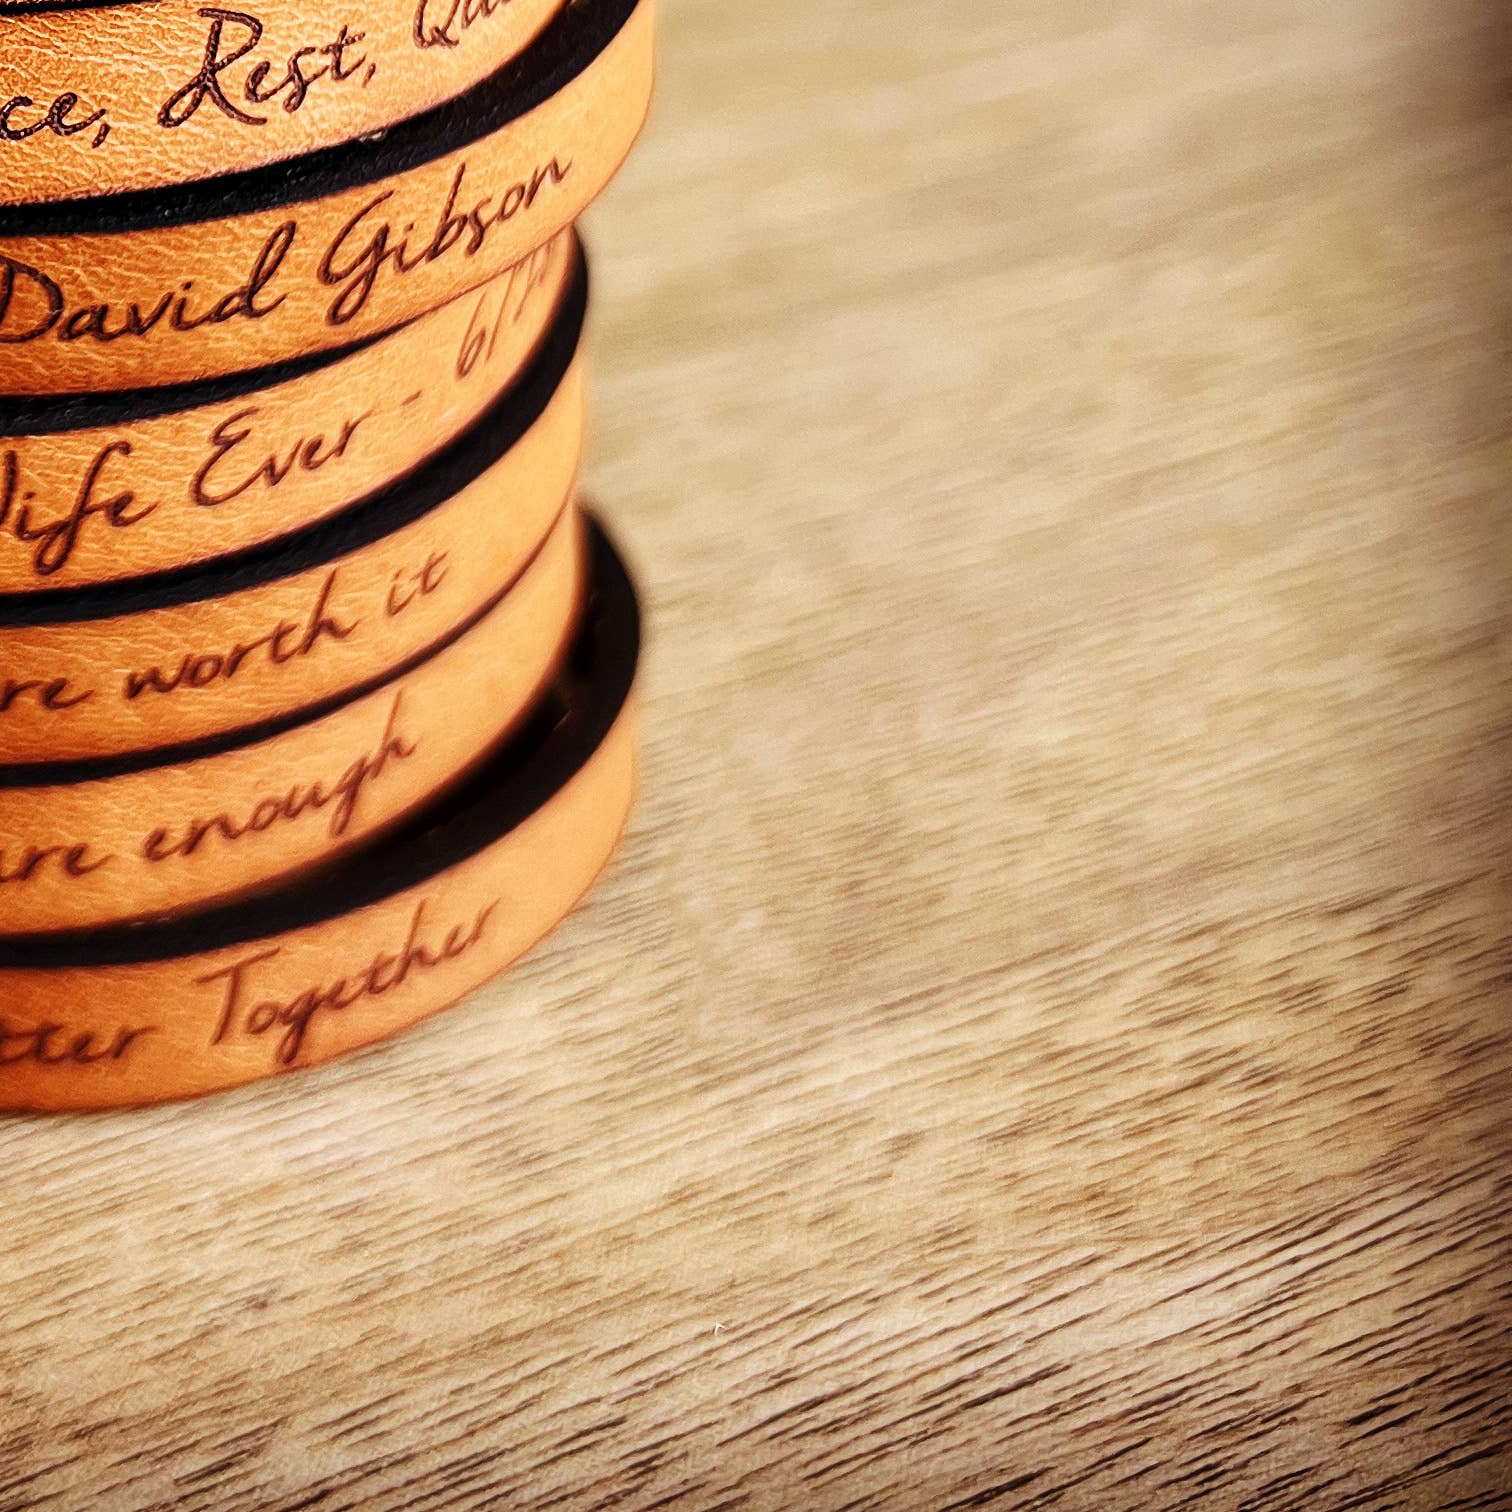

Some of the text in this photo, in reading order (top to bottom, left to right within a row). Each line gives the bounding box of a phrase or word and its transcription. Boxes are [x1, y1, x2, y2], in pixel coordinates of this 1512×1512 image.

[158, 7, 375, 128] Rest,
[317, 154, 572, 326] Gibson
[188, 407, 373, 509] Ever
[125, 570, 361, 700] worth
[385, 548, 449, 615] it
[143, 689, 420, 863] enough
[194, 896, 500, 1070] Together
